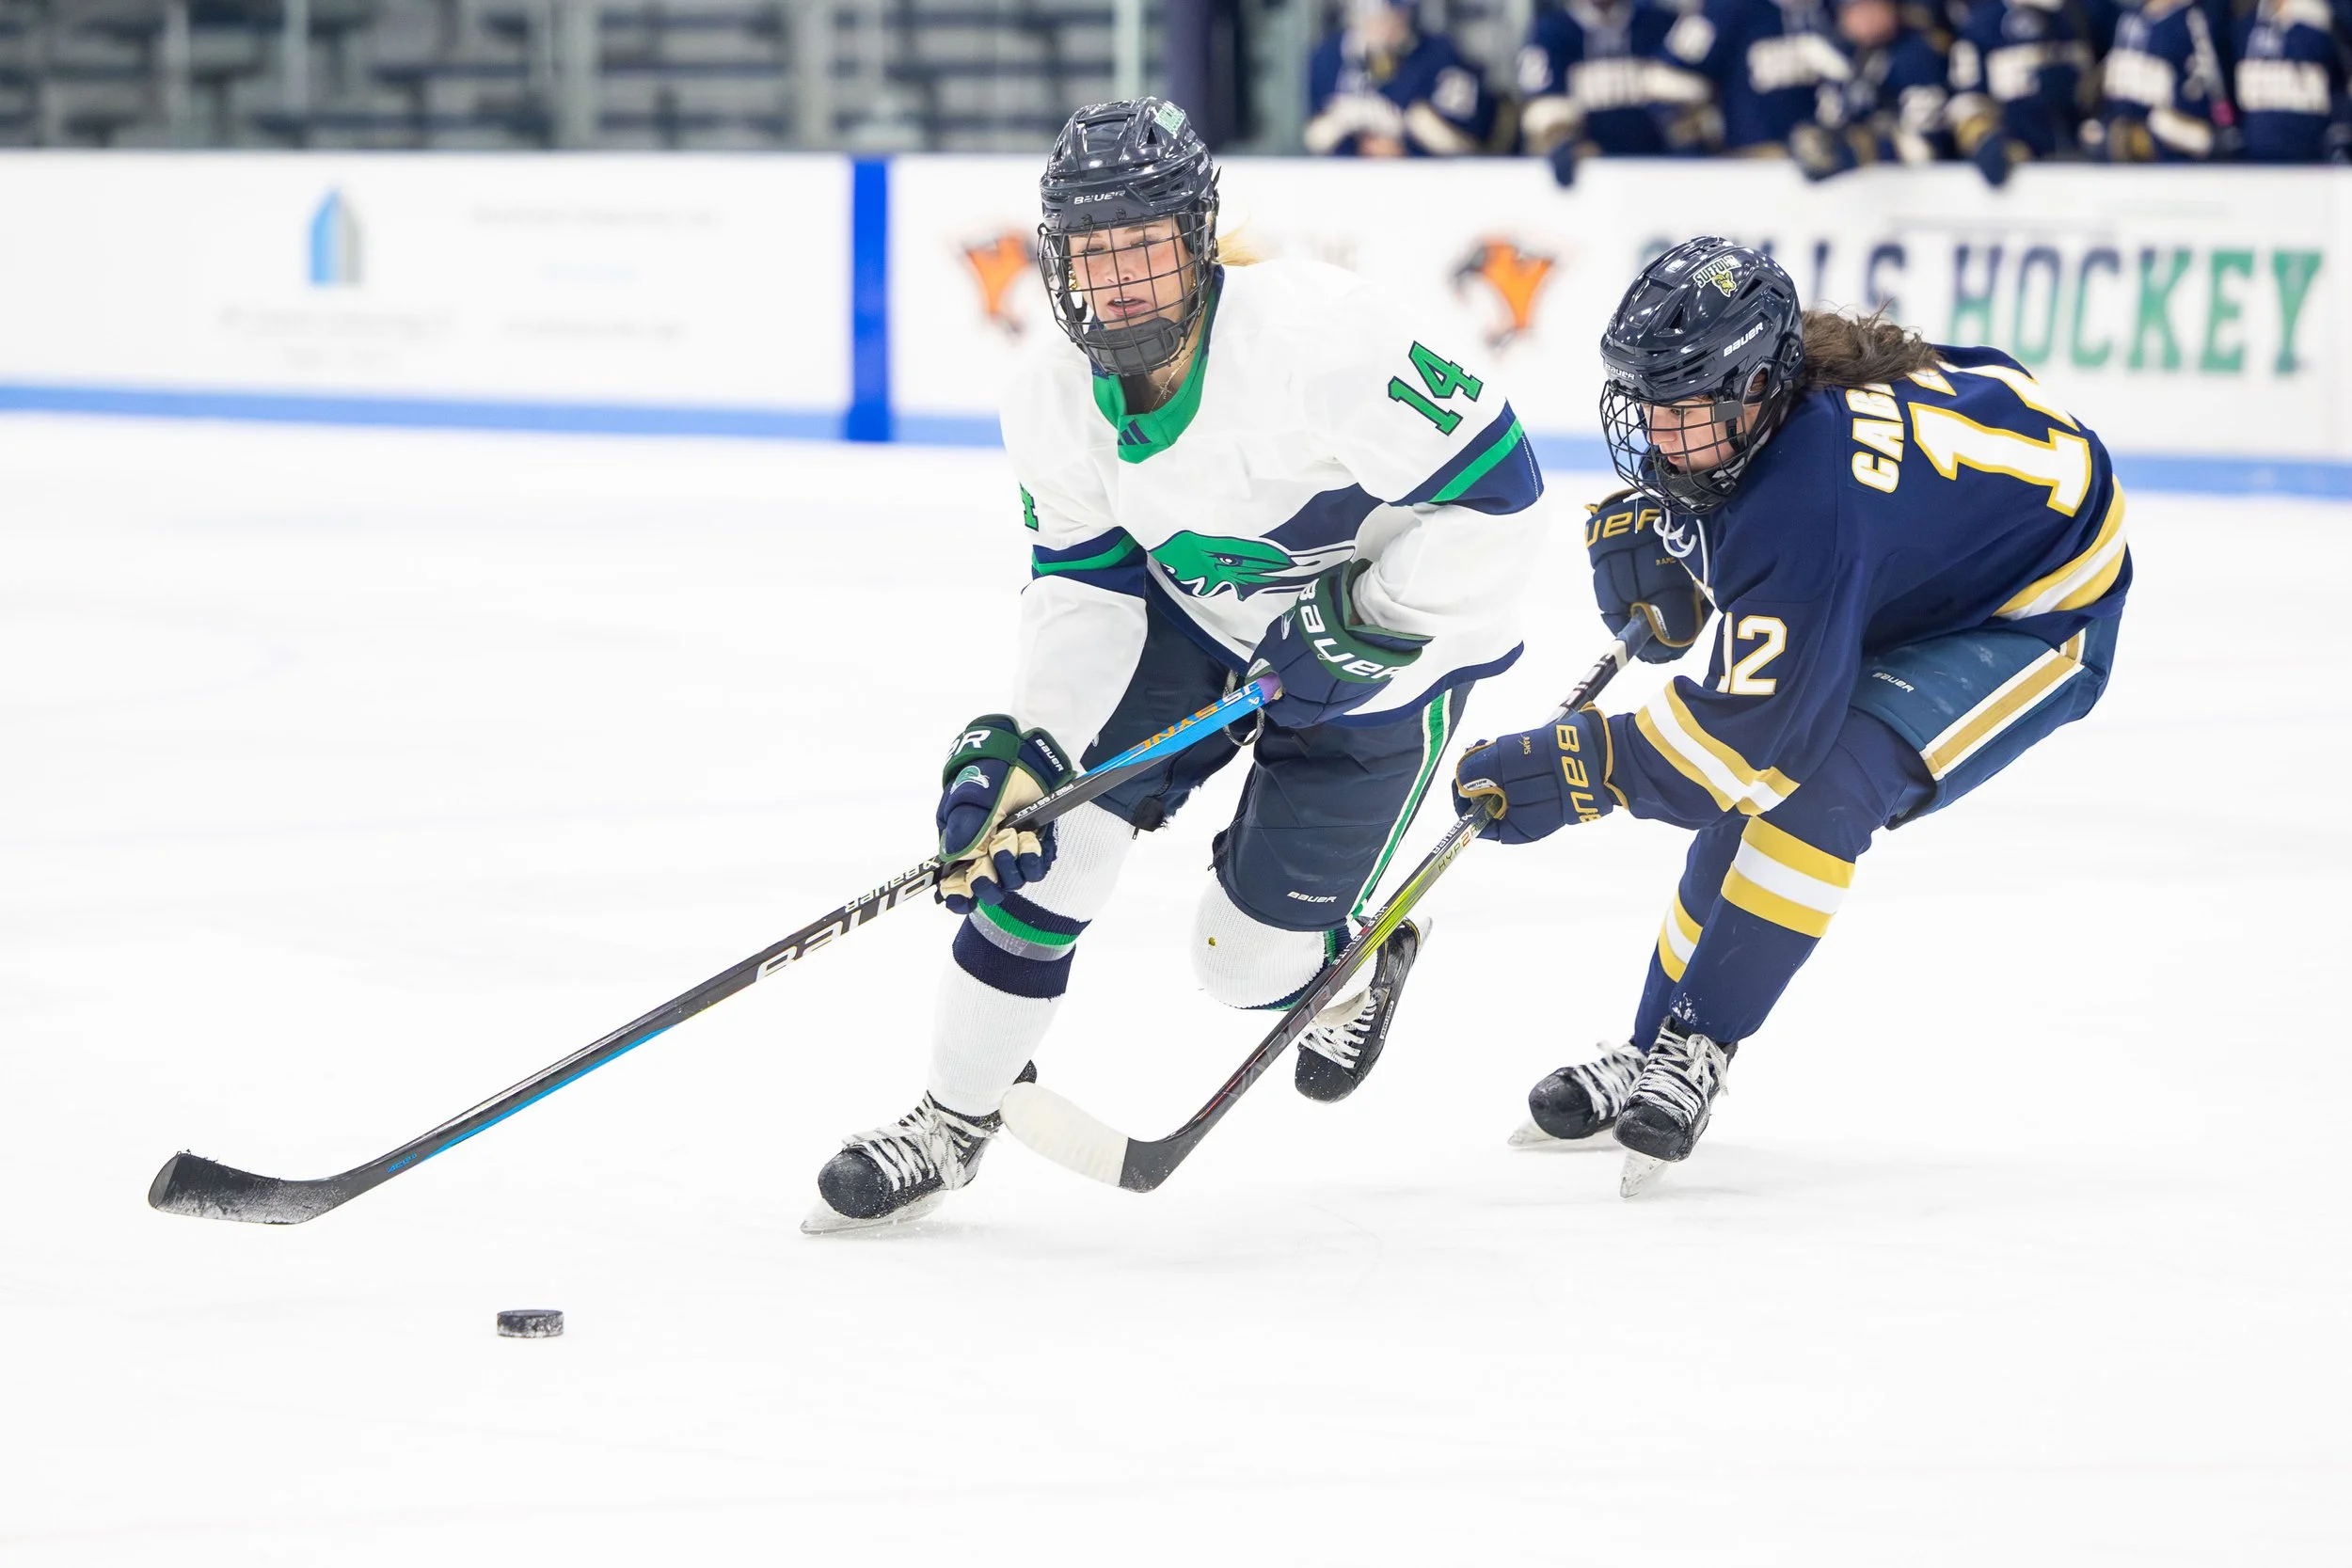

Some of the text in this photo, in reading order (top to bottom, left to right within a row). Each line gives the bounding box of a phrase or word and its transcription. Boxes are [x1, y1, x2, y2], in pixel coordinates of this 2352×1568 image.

[1947, 242, 2323, 374] HOCKEY
[1724, 322, 1763, 357] BAUER
[1388, 341, 1484, 436] 14
[1846, 383, 1903, 493] CAB
[1872, 672, 1915, 693] BAUER
[1035, 738, 1064, 772] BAUER
[1014, 805, 1038, 819] FLEX
[1287, 891, 1337, 903] BAUER
